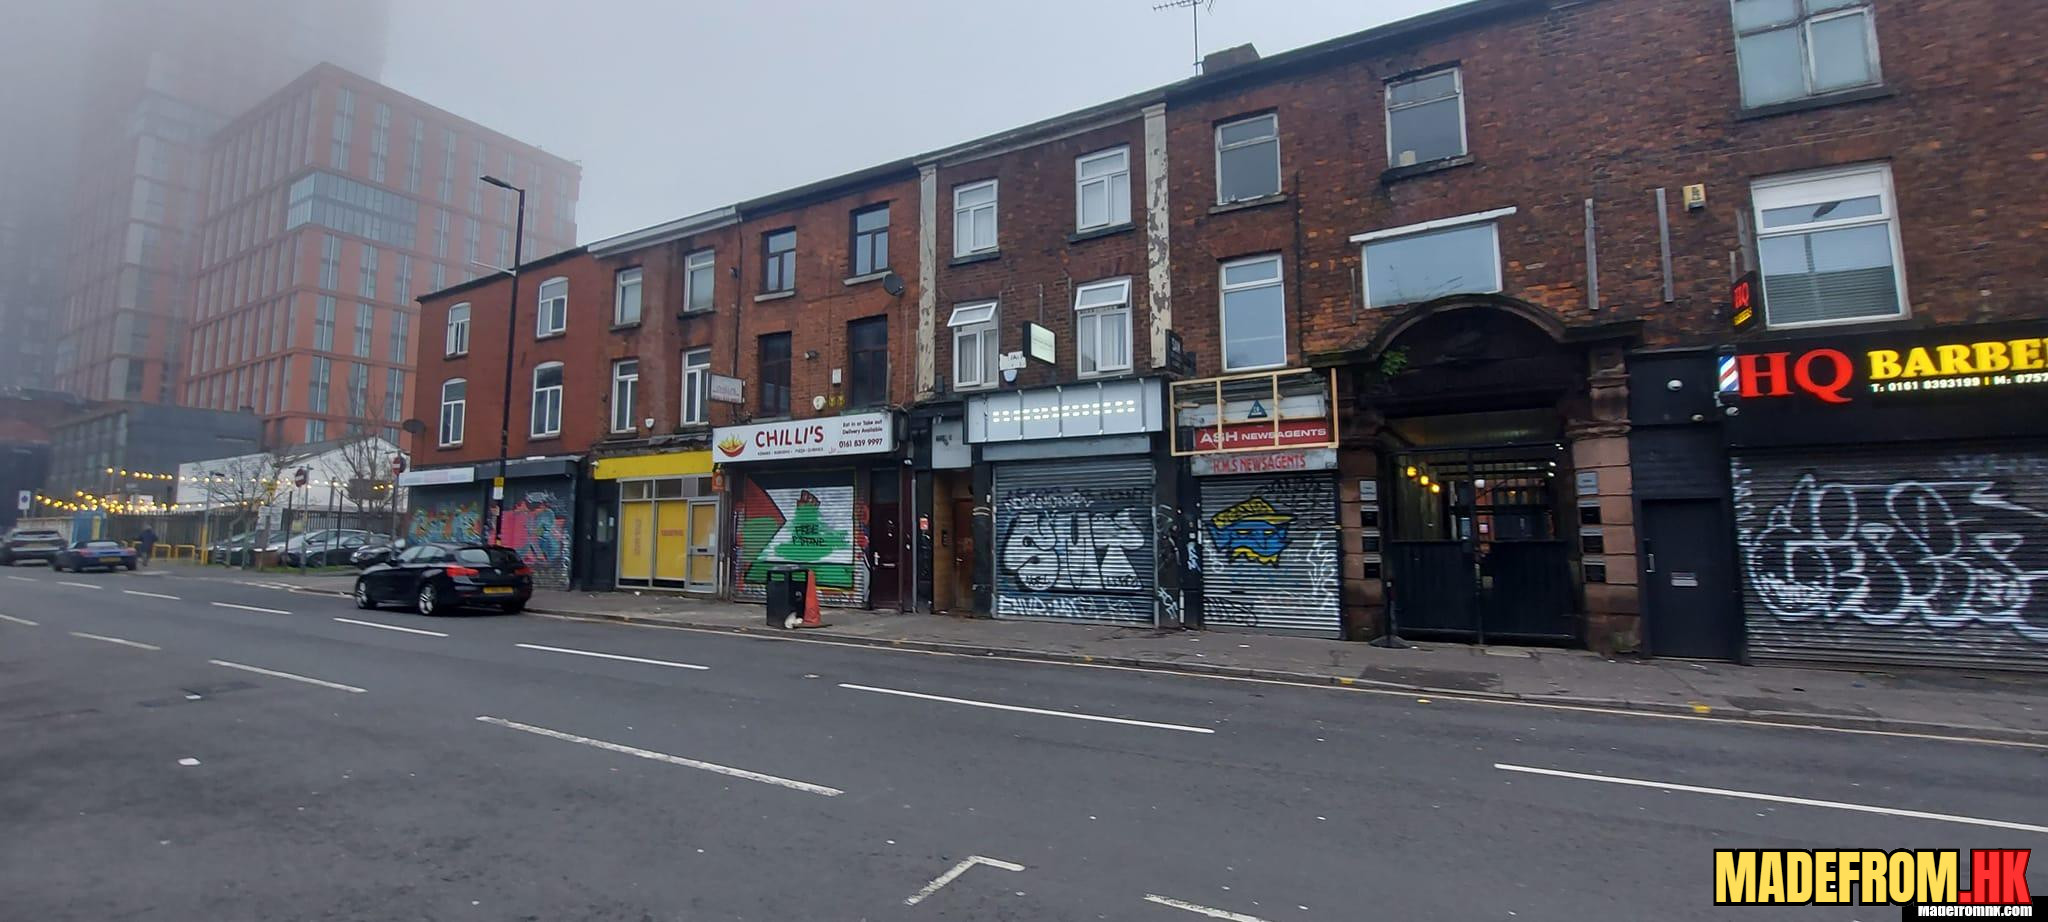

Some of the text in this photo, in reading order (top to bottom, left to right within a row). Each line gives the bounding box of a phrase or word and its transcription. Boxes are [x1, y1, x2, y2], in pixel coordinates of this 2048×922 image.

[1737, 338, 2048, 404] HQ BARBE
[1870, 372, 2048, 393] T: 0161 8393199 M: 0757
[755, 425, 824, 448] CHILLI'S
[838, 438, 883, 449] 0161 839 9997
[1200, 428, 1327, 444] ASH NEWSAGENTS
[1240, 454, 1306, 471] NEWSAGENTS
